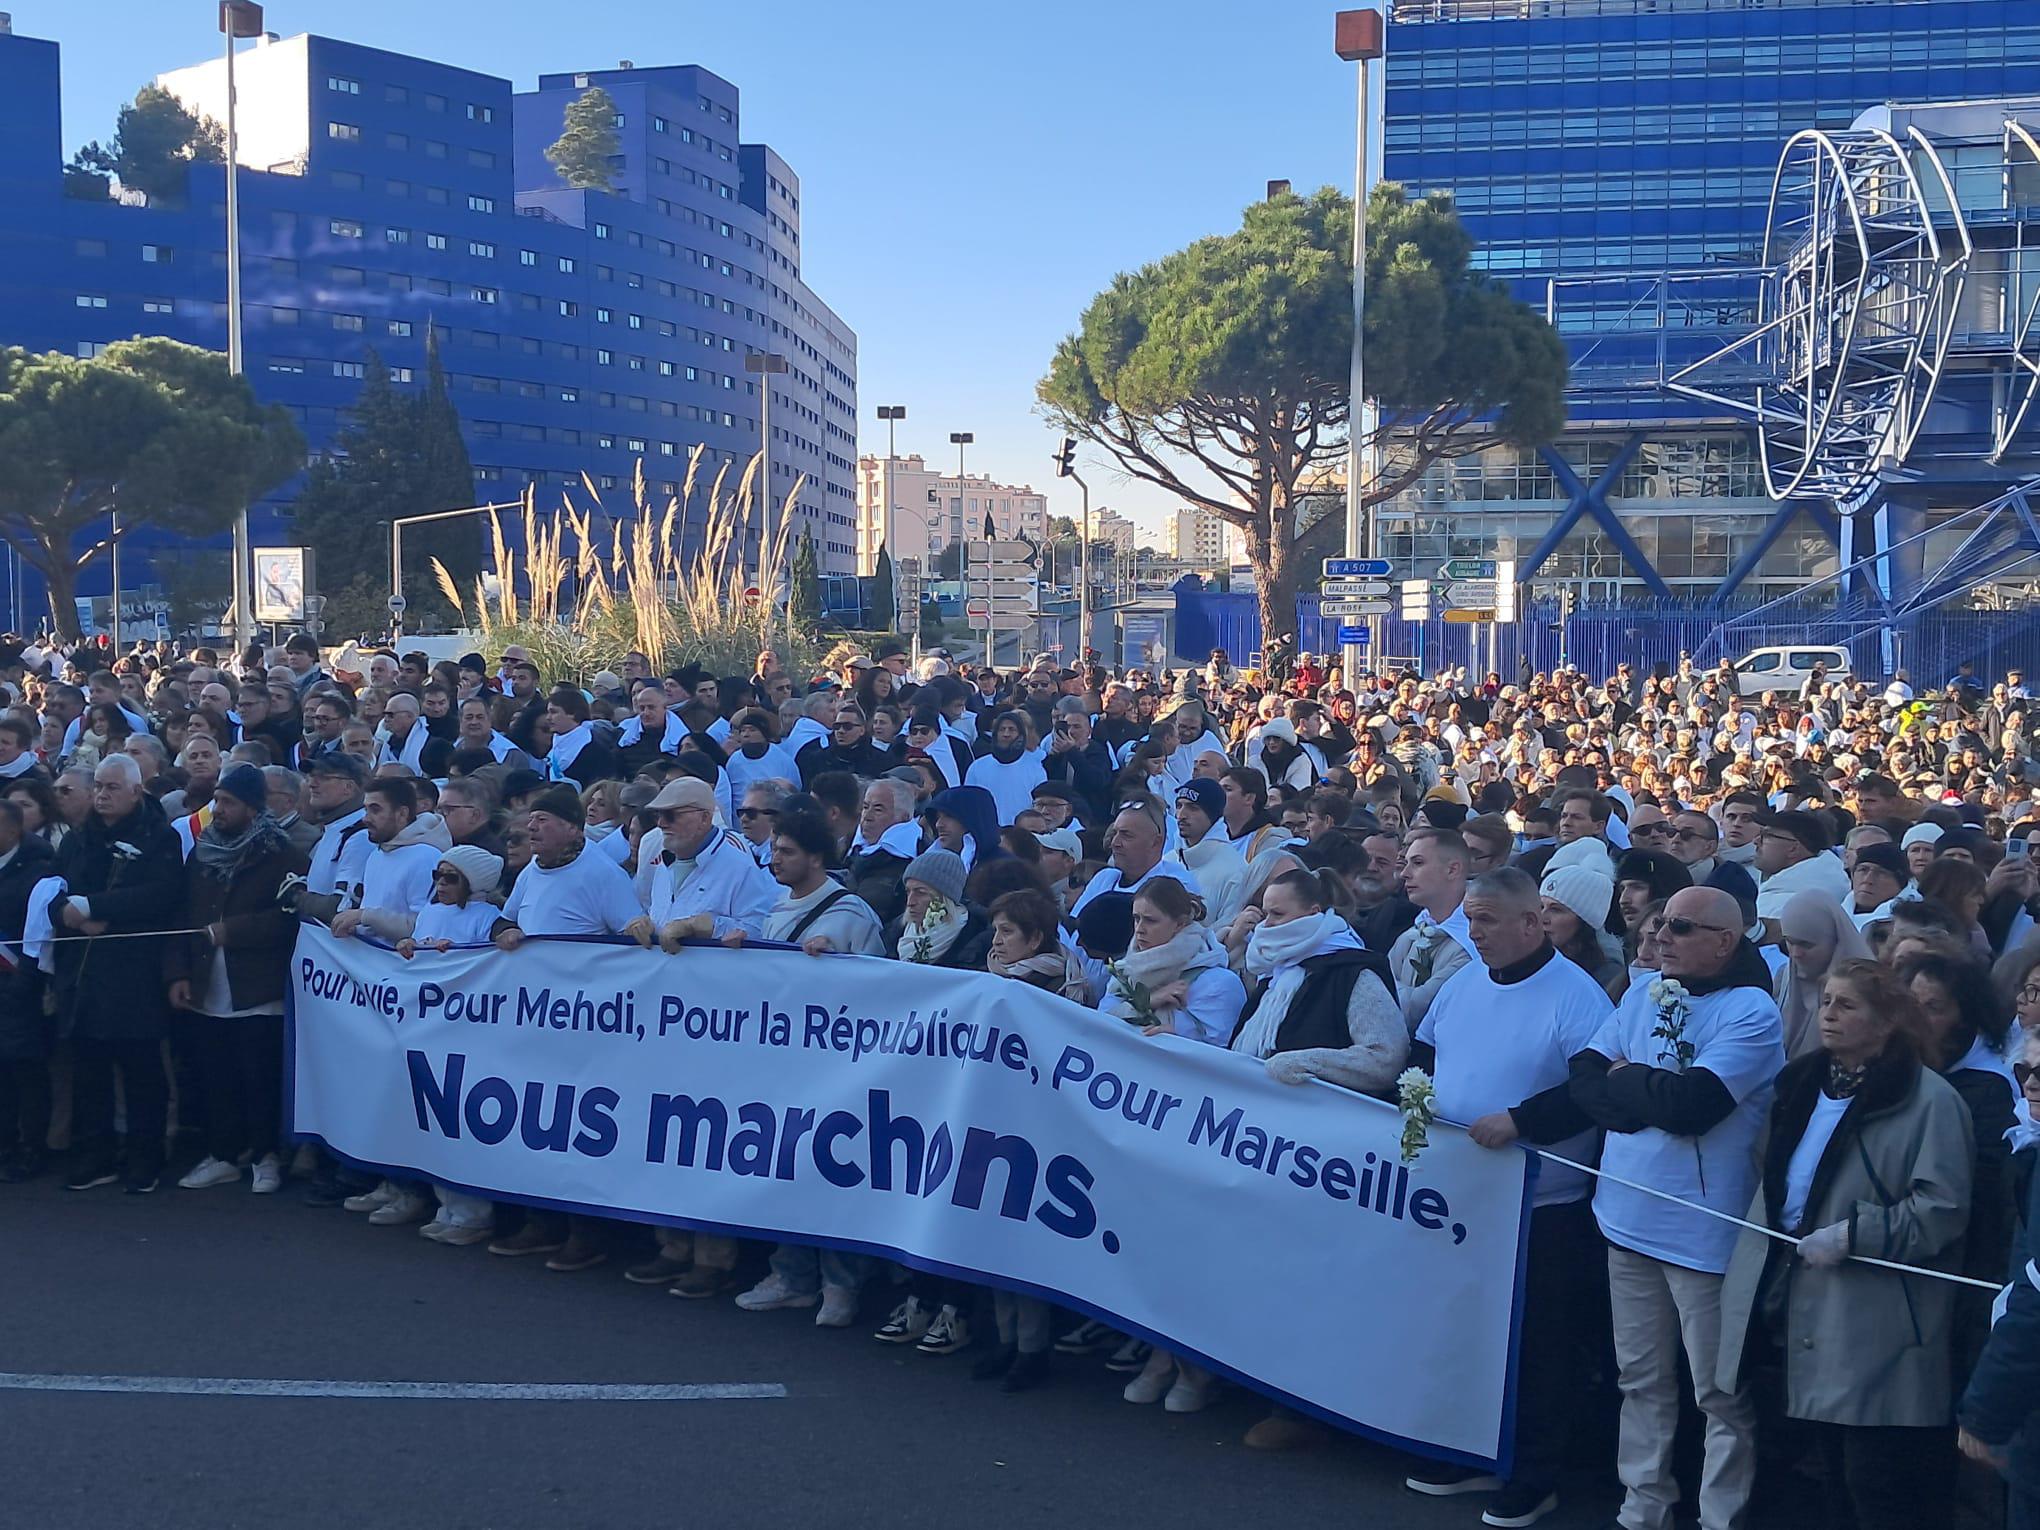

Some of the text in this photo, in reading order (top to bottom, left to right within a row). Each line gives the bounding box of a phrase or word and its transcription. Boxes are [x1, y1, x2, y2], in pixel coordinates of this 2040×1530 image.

[1343, 563, 1372, 572] A 507
[1328, 583, 1367, 593] MALPASSÉ
[1327, 604, 1363, 613] LA ROSE
[302, 957, 349, 1002] Pour
[364, 977, 405, 1024] vie,
[418, 981, 507, 1024] Pour
[515, 985, 645, 1042] Mehdi,
[658, 994, 750, 1044] Pour
[759, 998, 791, 1047] la
[803, 1003, 1040, 1086] République,
[1051, 1044, 1183, 1132] Pour
[1187, 1095, 1468, 1246] Marseille,
[406, 1049, 1121, 1255] Nous marchons.
